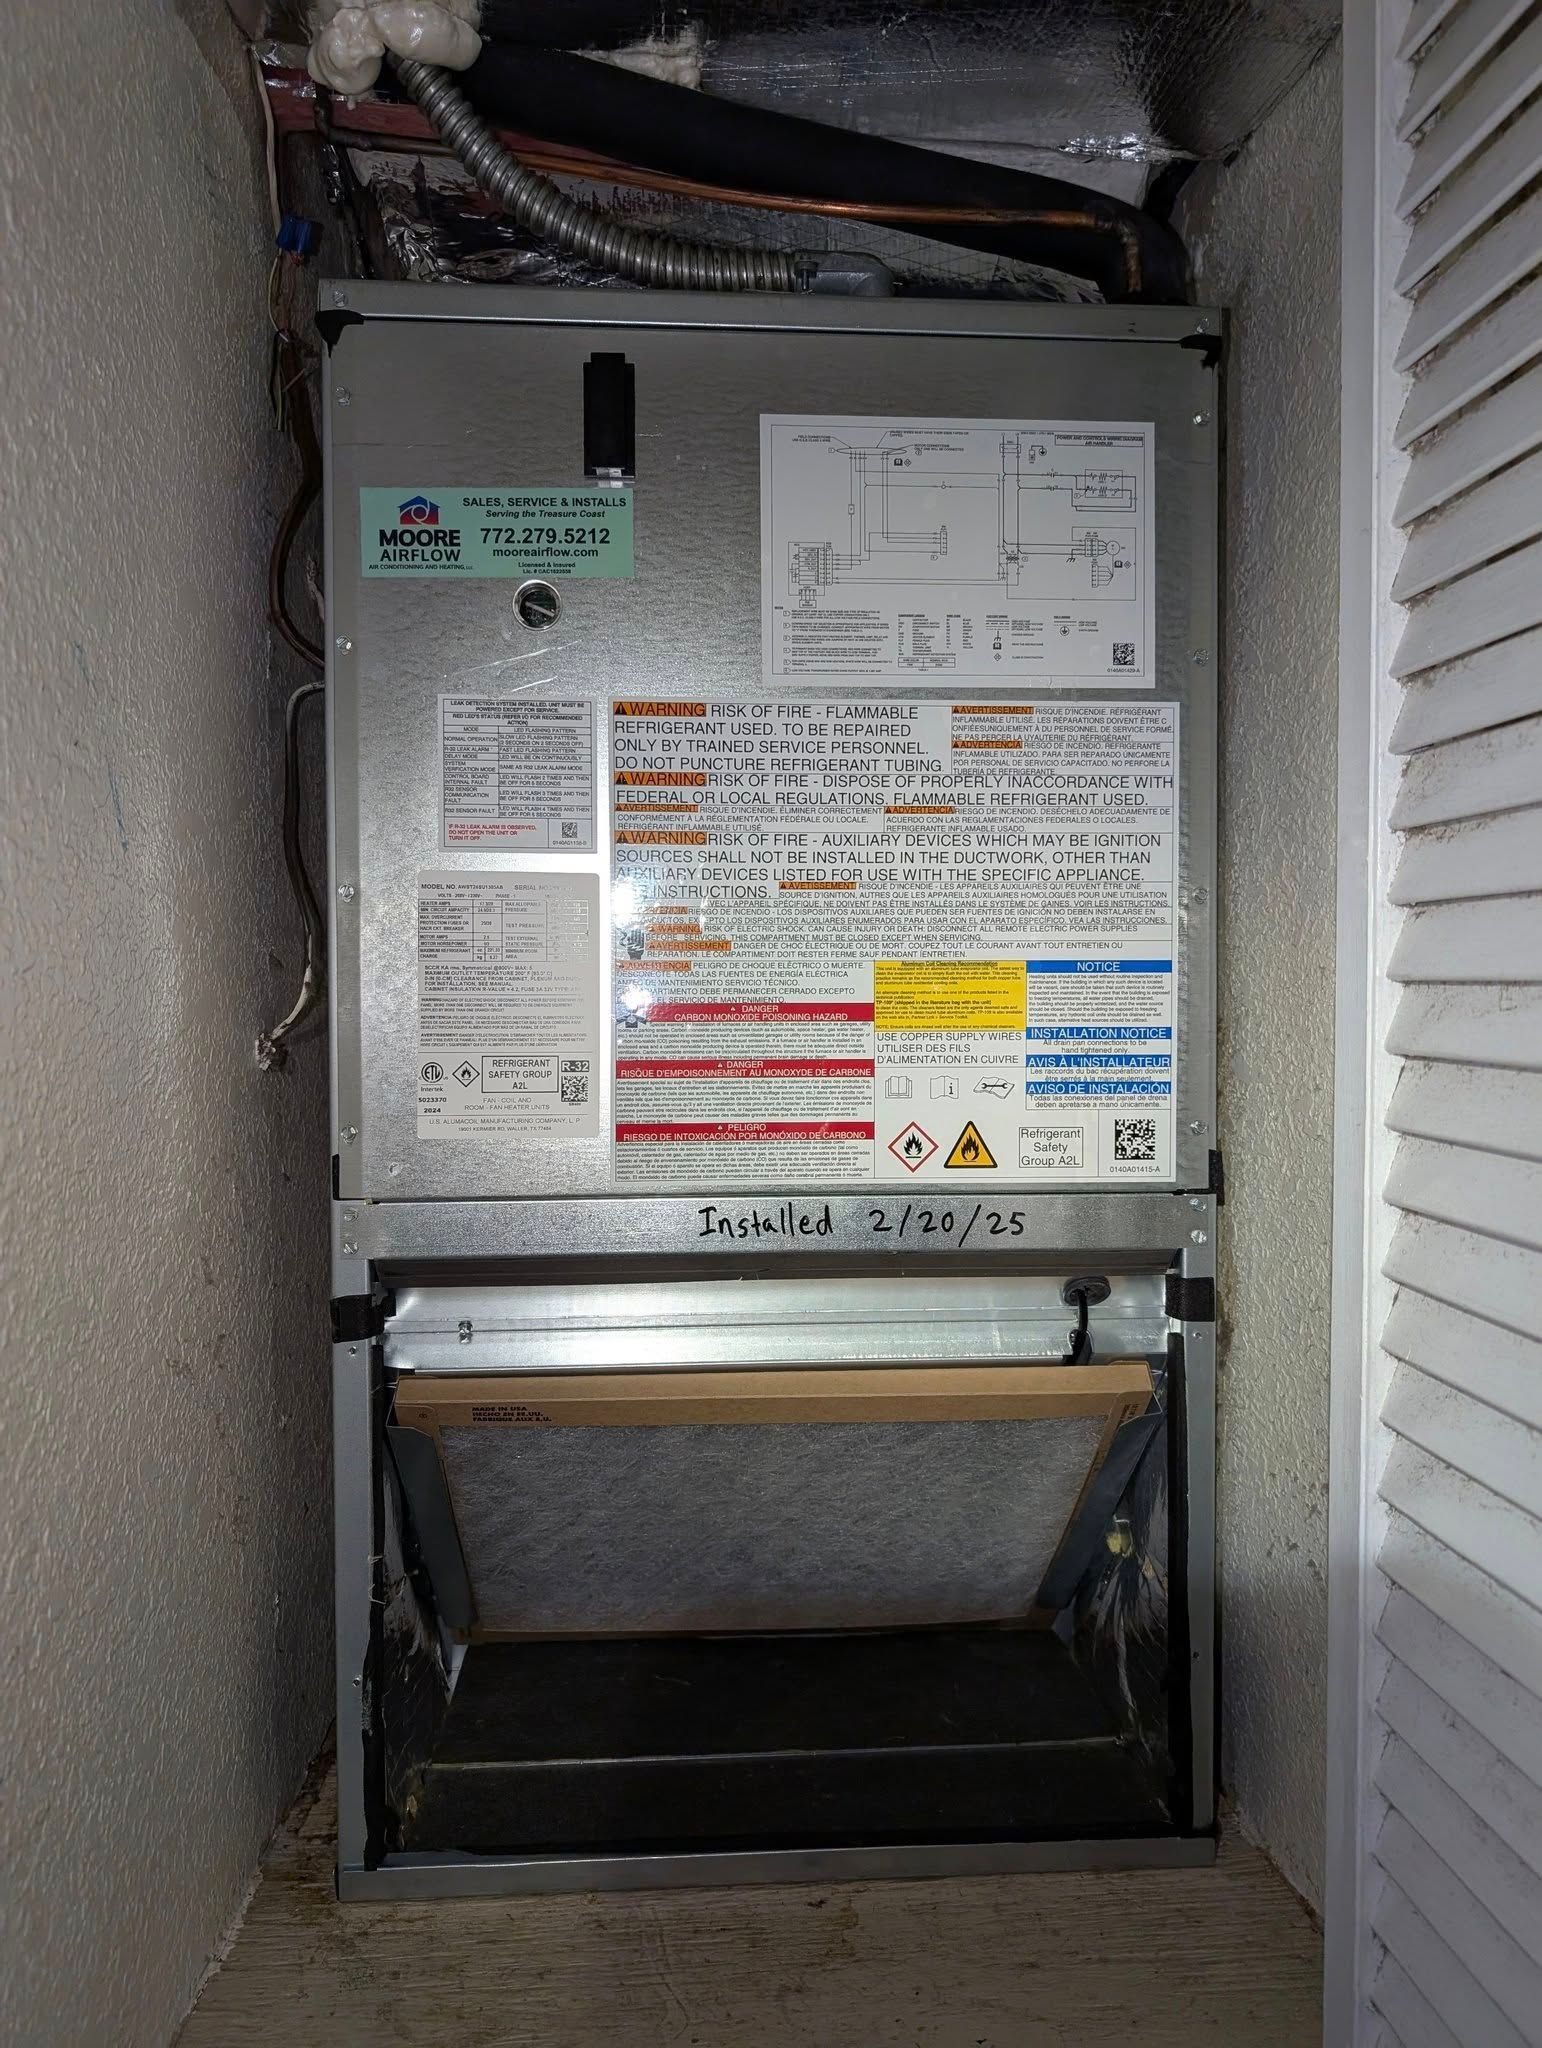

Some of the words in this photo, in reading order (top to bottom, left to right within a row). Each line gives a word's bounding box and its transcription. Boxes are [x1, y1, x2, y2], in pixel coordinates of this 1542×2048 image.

[463, 497, 503, 508] SALES,
[508, 498, 556, 506] SERVICE
[560, 498, 568, 506] &
[572, 498, 626, 506] INSTALLS
[486, 510, 519, 519] Serving
[379, 529, 460, 546] MOORE
[480, 528, 609, 544] 772.279.5212
[380, 549, 460, 561] AIRFLOW
[493, 547, 598, 556] mooreairflow.com
[630, 703, 705, 716] WARNING
[711, 704, 746, 717] RISK
[751, 704, 772, 717] OF
[778, 704, 811, 718] FIRE
[826, 705, 918, 719] FLAMMABLE
[961, 706, 1031, 714] AVERTISSEMENT
[615, 721, 726, 735] REFRIGERANT
[731, 722, 776, 735] USED.
[782, 723, 803, 735] TO
[808, 723, 827, 735] BE
[834, 724, 910, 736] REPAIRED
[614, 739, 656, 751] ONLY
[662, 739, 681, 751] BY
[686, 739, 753, 752] TRAINED
[759, 740, 825, 754] SERVICE
[831, 741, 928, 754] PERSONNEL.
[614, 756, 637, 769] DO
[643, 756, 675, 769] NOT
[680, 757, 764, 770] PUNCTURE
[771, 758, 879, 771] REFRIGERANT
[630, 773, 705, 785] WARNING
[708, 775, 743, 786] RISK
[748, 775, 769, 786] OF
[774, 775, 808, 787] FIRE
[823, 775, 890, 787] DISPOSE
[895, 775, 915, 787] OF
[921, 775, 1002, 788] PROPERLY
[1134, 776, 1173, 788] WITH
[617, 790, 688, 803] FEDERAL
[692, 791, 714, 803] OR
[720, 791, 770, 804] LOCAL
[776, 792, 887, 805] REGULATIONS.
[894, 792, 984, 805] FLAMMABLE
[990, 792, 1098, 805] REFRIGERANT
[1103, 793, 1147, 805] USED.
[631, 832, 706, 844] WARNING
[708, 833, 742, 845] RISK
[748, 833, 768, 846] OF
[774, 834, 807, 846] FIRE
[822, 834, 900, 846] AUXILIARY
[906, 834, 971, 846] DEVICES
[976, 834, 1027, 846] WHICH
[1033, 834, 1064, 846] MAY
[1070, 834, 1088, 846] BE
[1094, 833, 1160, 846] IGNITION
[616, 849, 692, 862] SOURCES
[698, 850, 746, 863] SHALL
[751, 851, 782, 863] NOT
[788, 851, 806, 863] BE
[813, 851, 894, 864] INSTALLED
[900, 851, 914, 863] IN
[918, 851, 948, 863] THE
[954, 851, 1046, 865] DUCTWORK,
[1052, 851, 1104, 864] OTHER
[1109, 851, 1150, 863] THAN
[702, 868, 768, 880] DEVICES
[774, 868, 826, 881] LISTED
[832, 868, 862, 881] FOR
[868, 868, 897, 881] USE
[902, 868, 941, 880] WITH
[946, 869, 976, 881] THE
[982, 868, 1050, 881] SPECIFIC
[1056, 868, 1144, 882] APPLIANCE.
[1077, 962, 1120, 971] NOTICE
[674, 1013, 711, 1021] CARBON
[762, 1013, 810, 1021] POISONING
[812, 1013, 847, 1021] HAZARD
[877, 1032, 896, 1041] USE
[900, 1032, 942, 1041] COPPER
[946, 1032, 985, 1041] SUPPLY
[988, 1032, 1021, 1040] WIRES
[1031, 1028, 1116, 1039] INSTALLATION
[1121, 1028, 1166, 1039] NOTICE
[877, 1044, 922, 1052] UTILISER
[926, 1044, 946, 1052] DES
[949, 1044, 970, 1052] FILS
[492, 1059, 550, 1067] REFRIGERANT
[877, 1055, 960, 1064] D'ALIMENTATION
[964, 1055, 977, 1063] EN
[980, 1055, 1018, 1063] CUIVRE
[1028, 1057, 1055, 1067] AVIS
[1059, 1057, 1073, 1067] À
[1073, 1057, 1169, 1067] L'INSTALLATEUR
[562, 1061, 589, 1071] R-32
[621, 1069, 653, 1077] RISQUE
[656, 1069, 746, 1077] D'EMPOISONNEMENT
[815, 1068, 826, 1076] DE
[829, 1068, 870, 1076] CARBONE
[1028, 1084, 1064, 1094] AVISO
[1069, 1084, 1084, 1094] DE
[1089, 1082, 1168, 1094] INSTALACIÓN
[726, 1123, 766, 1132] PELIGRO
[624, 1133, 657, 1141] RIESGO
[674, 1131, 736, 1141] INTOXICACIÓN
[738, 1132, 757, 1140] POR
[759, 1131, 806, 1140] MONÓXIDO
[823, 1131, 865, 1139] CARBONO
[1021, 1128, 1080, 1140] Refrigerant
[1034, 1142, 1067, 1154] Safety
[1021, 1156, 1054, 1166] Group
[1058, 1156, 1079, 1166] A2L
[699, 1201, 834, 1238] Installed
[869, 1204, 1026, 1247] 2/20/25
